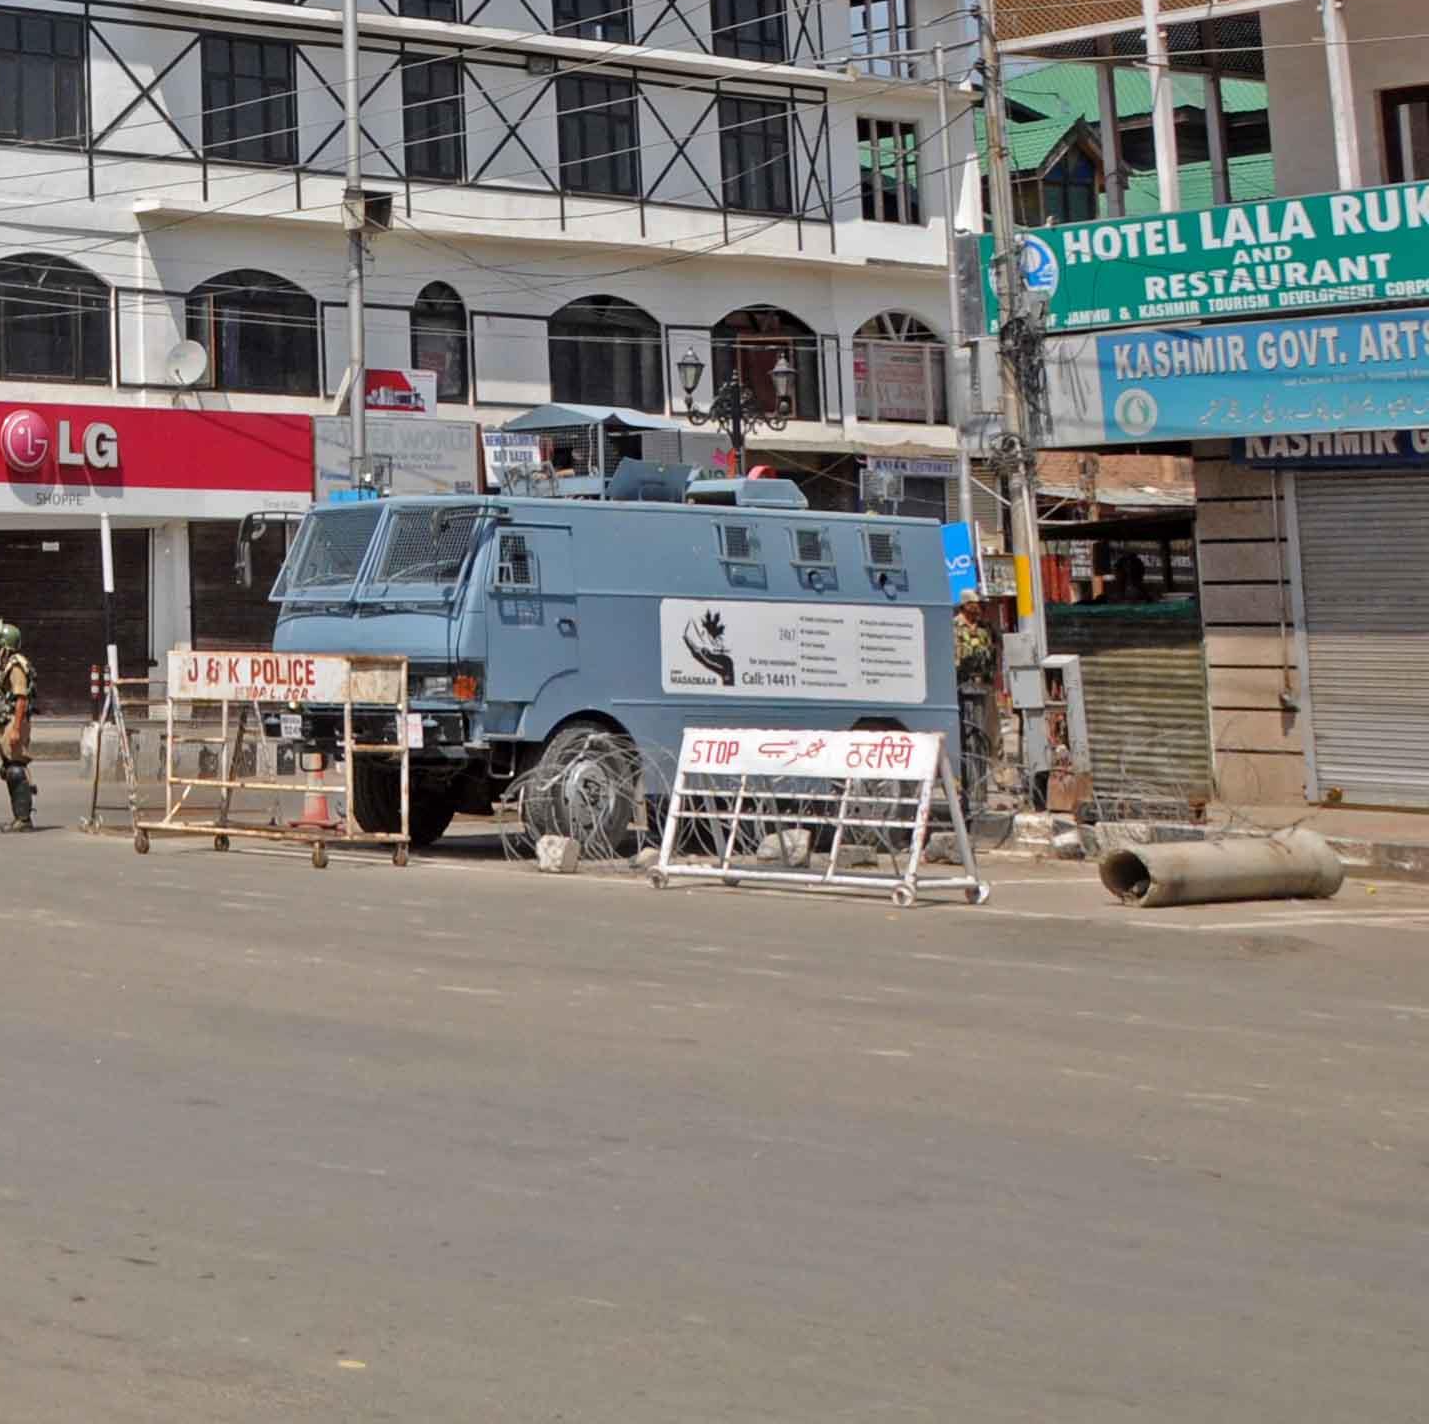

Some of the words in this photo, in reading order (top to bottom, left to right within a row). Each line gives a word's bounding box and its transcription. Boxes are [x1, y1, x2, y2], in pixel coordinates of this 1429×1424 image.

[1063, 220, 1187, 266] HOTEL
[1199, 201, 1316, 251] LALA
[1233, 245, 1293, 265] AND
[1145, 253, 1391, 303] RESTAURANT
[1065, 308, 1111, 326] JAMMU
[1119, 307, 1131, 320] &
[1138, 300, 1200, 319] KASHMIR
[1208, 293, 1270, 313] TOURISM
[1279, 284, 1375, 307] DEVELOPMENT
[1113, 334, 1248, 380] KASHMIR
[1256, 327, 1349, 371] GOVT.
[58, 420, 118, 469] LG
[36, 492, 85, 506] SHOPPE
[188, 659, 198, 682] J
[206, 658, 220, 685] &
[228, 659, 240, 683] K
[251, 659, 316, 686] POLICE
[742, 672, 764, 685] Call:
[766, 673, 796, 686] 14411
[690, 740, 740, 765] STOP
